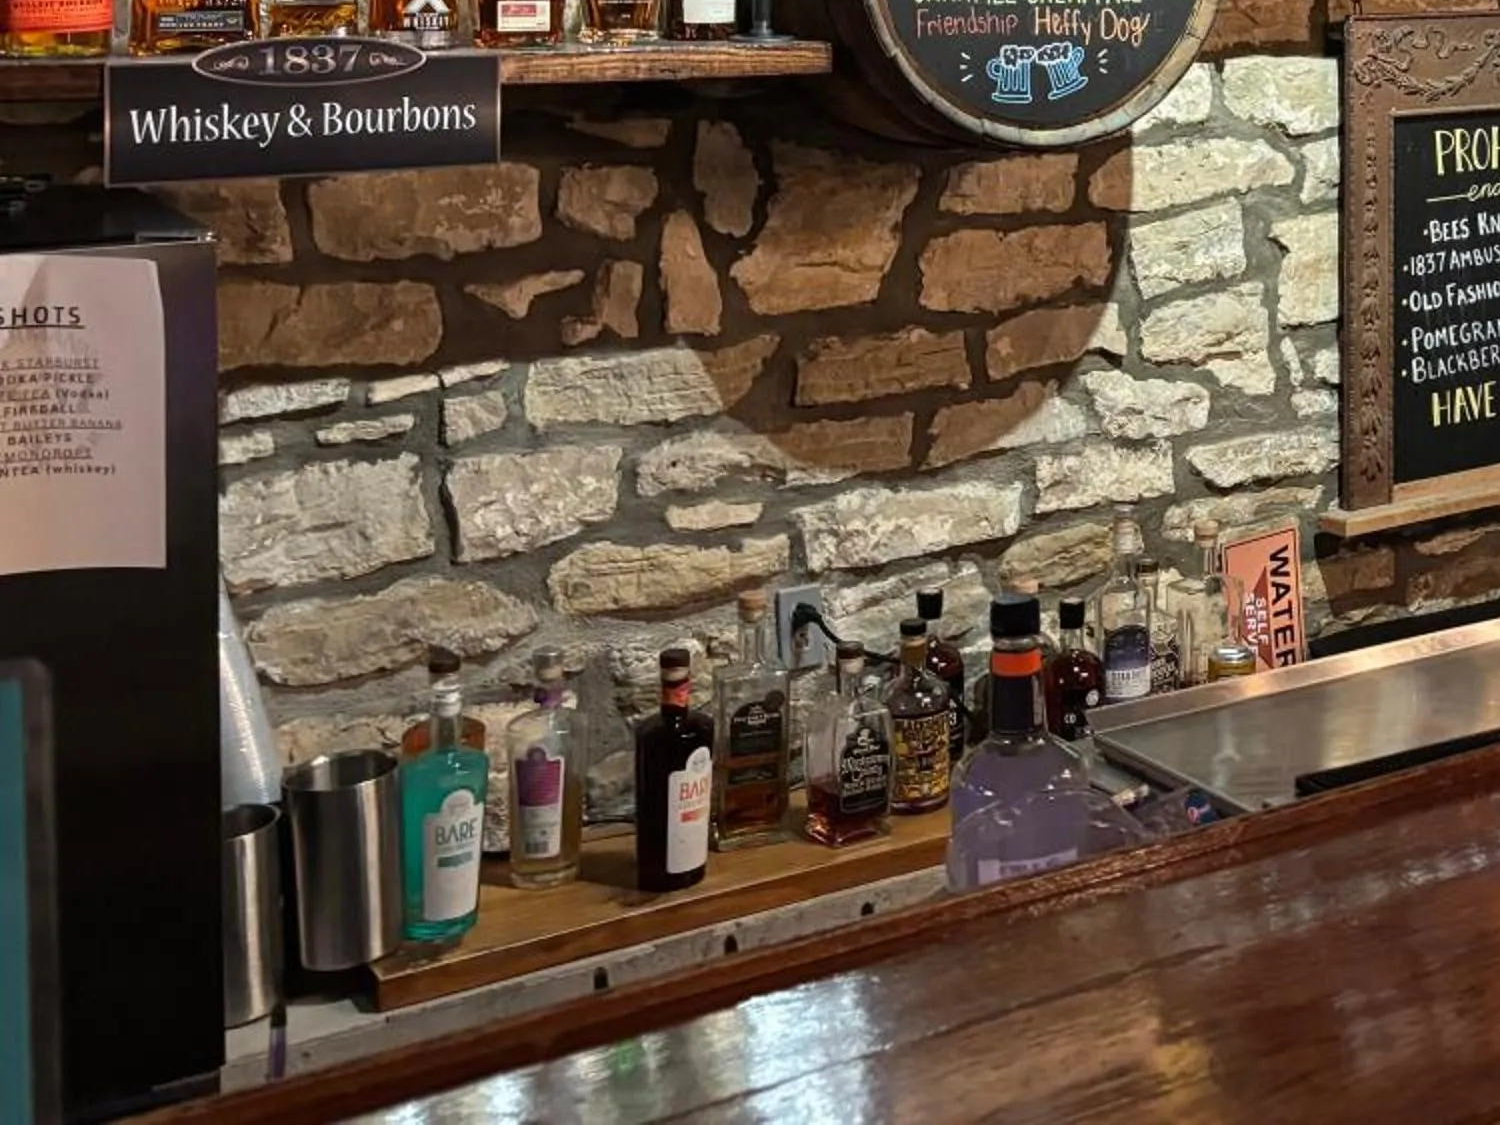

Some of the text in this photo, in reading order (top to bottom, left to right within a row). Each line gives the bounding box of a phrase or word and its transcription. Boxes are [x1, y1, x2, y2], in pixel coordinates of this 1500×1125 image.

[916, 9, 1151, 47] Friendship Heffy Dog
[258, 44, 363, 76] 1837
[129, 97, 478, 149] Whiskey & Bourbons
[1430, 219, 1470, 243] BEES
[1410, 251, 1446, 276] 1837
[1409, 291, 1442, 312] OLD
[43, 373, 95, 384] PICKLE
[3, 404, 76, 416] FIREBALL
[1431, 380, 1498, 428] HAVE
[7, 433, 72, 445] BAILEYS
[1269, 544, 1297, 669] WATER
[1255, 597, 1268, 645] SELF
